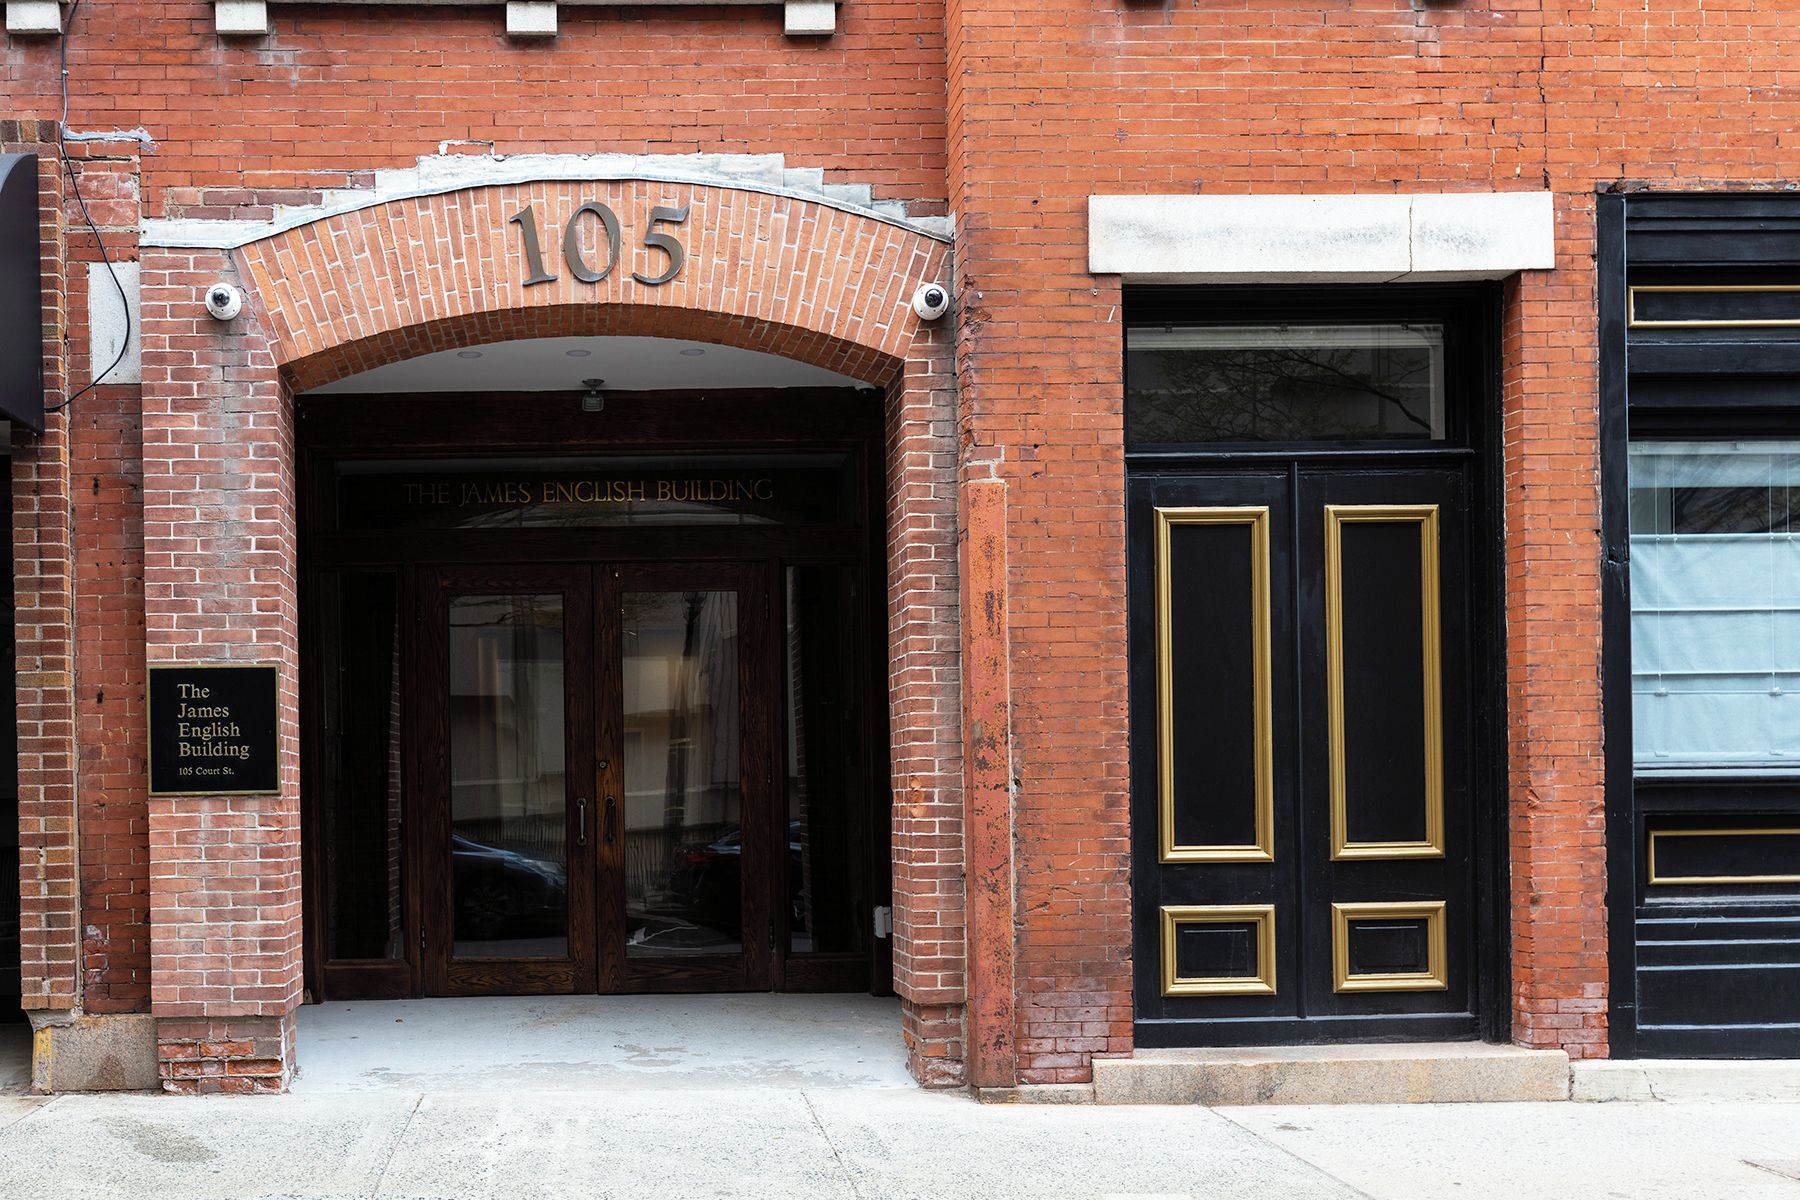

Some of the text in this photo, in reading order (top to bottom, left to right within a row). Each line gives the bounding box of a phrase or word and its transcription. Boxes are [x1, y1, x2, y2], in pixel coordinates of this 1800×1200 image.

[509, 202, 689, 286] 105
[403, 479, 774, 507] THE JAMES ENGLISH BUILDING
[177, 683, 210, 699] The
[178, 703, 230, 718] James
[178, 722, 241, 741] English
[178, 741, 250, 760] Building
[179, 767, 235, 776] 105 Court St.
